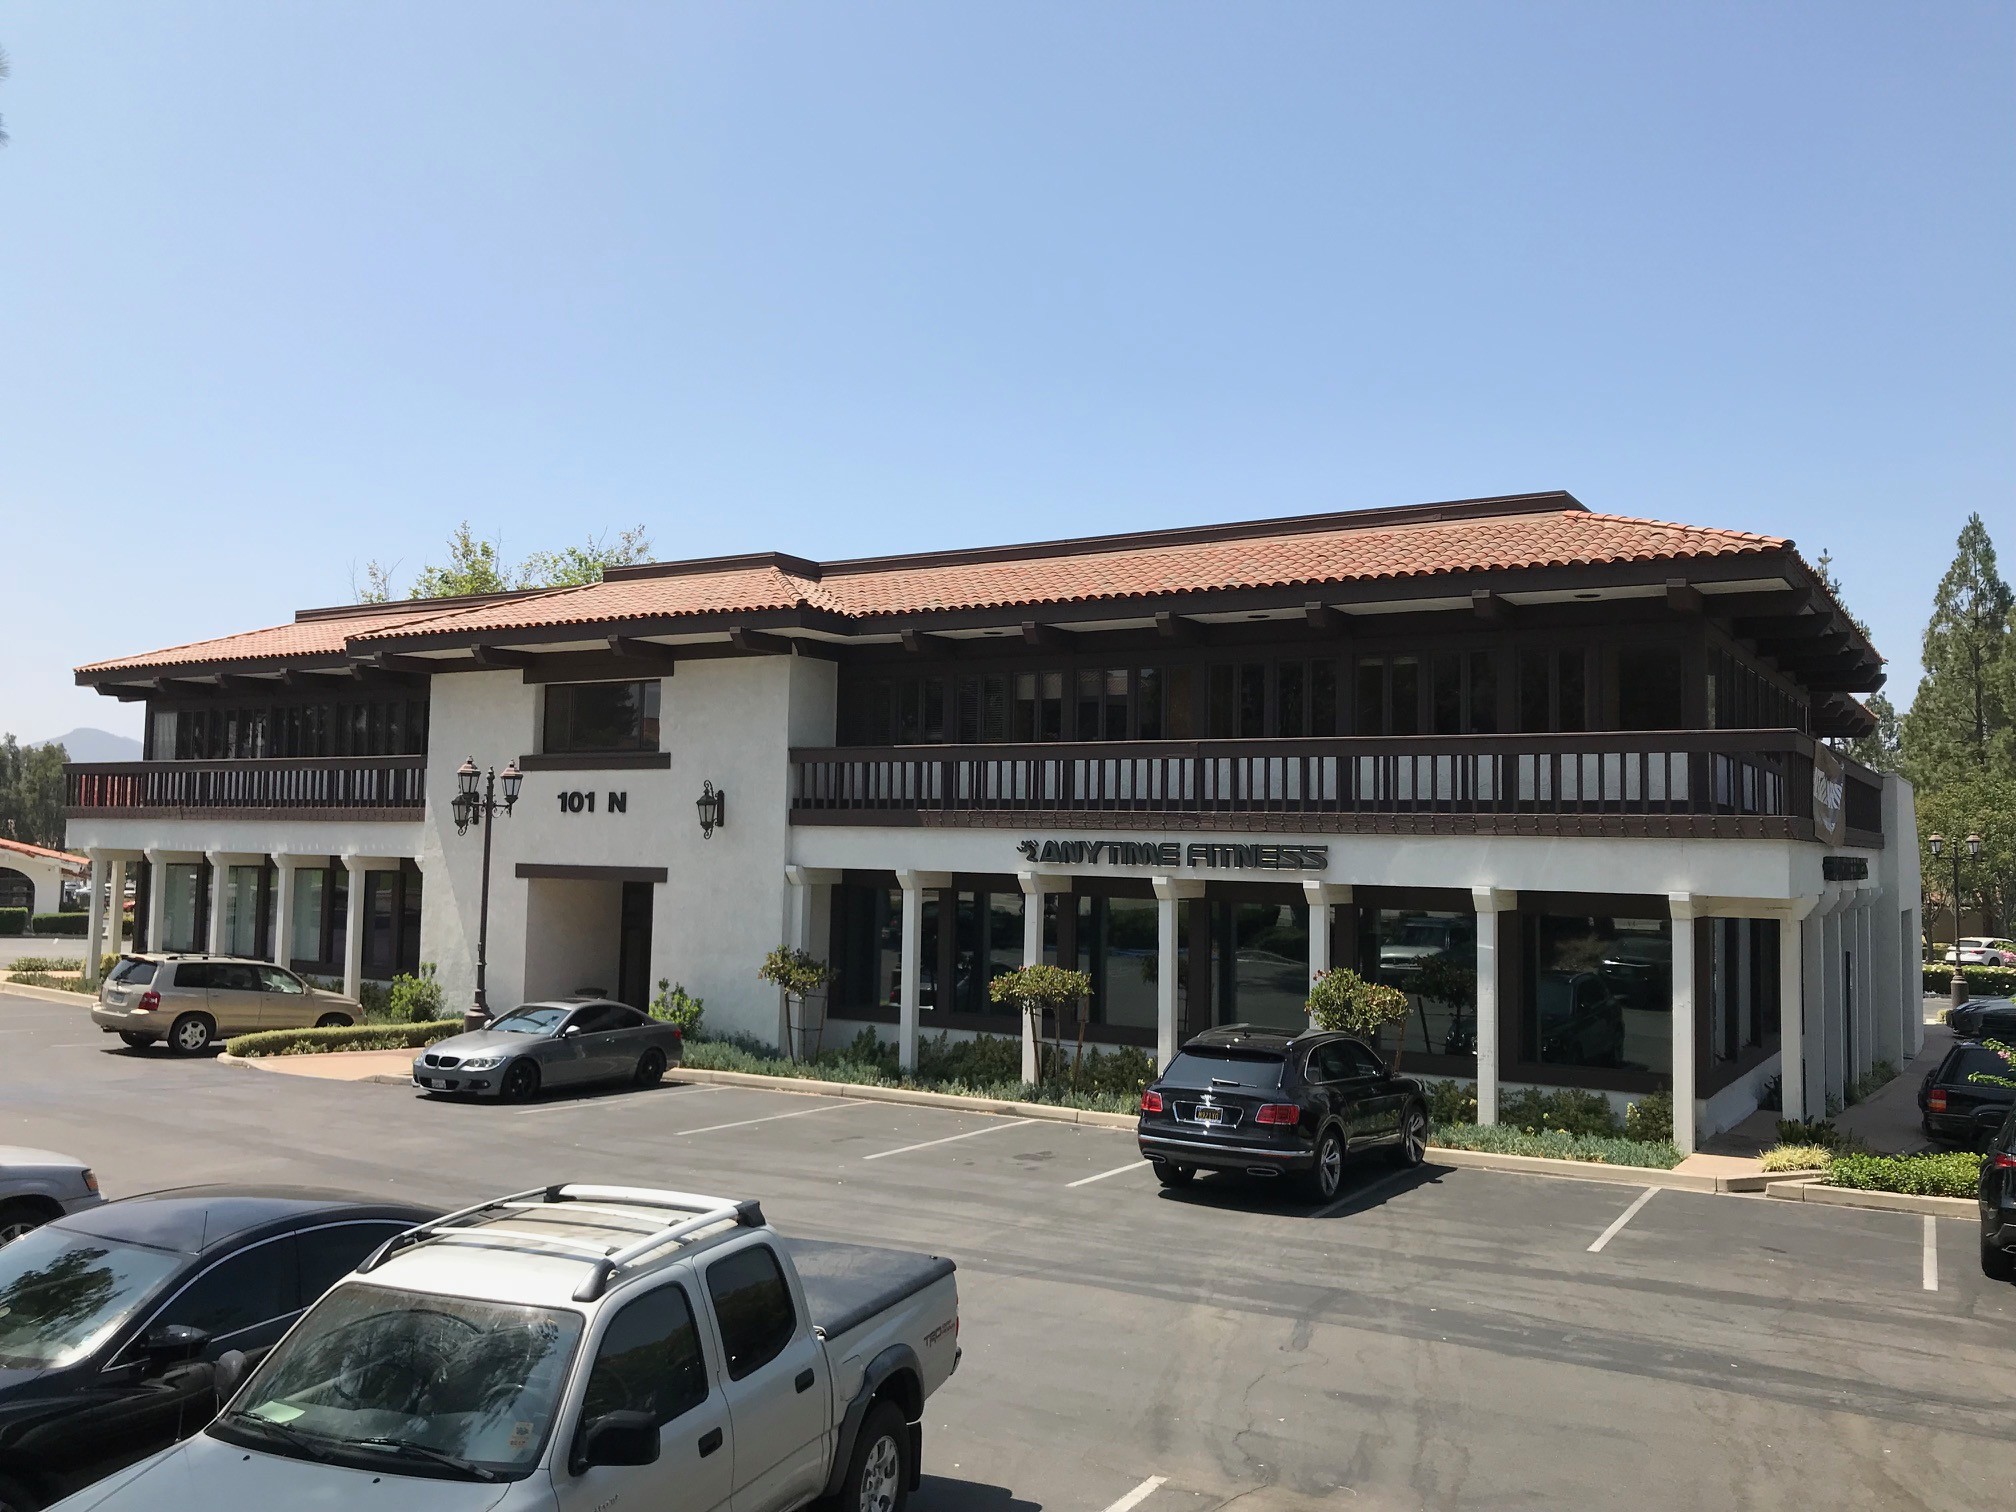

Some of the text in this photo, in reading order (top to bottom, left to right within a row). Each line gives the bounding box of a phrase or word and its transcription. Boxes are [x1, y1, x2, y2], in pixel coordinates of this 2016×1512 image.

[557, 791, 627, 813] 101 N
[1039, 840, 1329, 872] ANYTIME FITNESS
